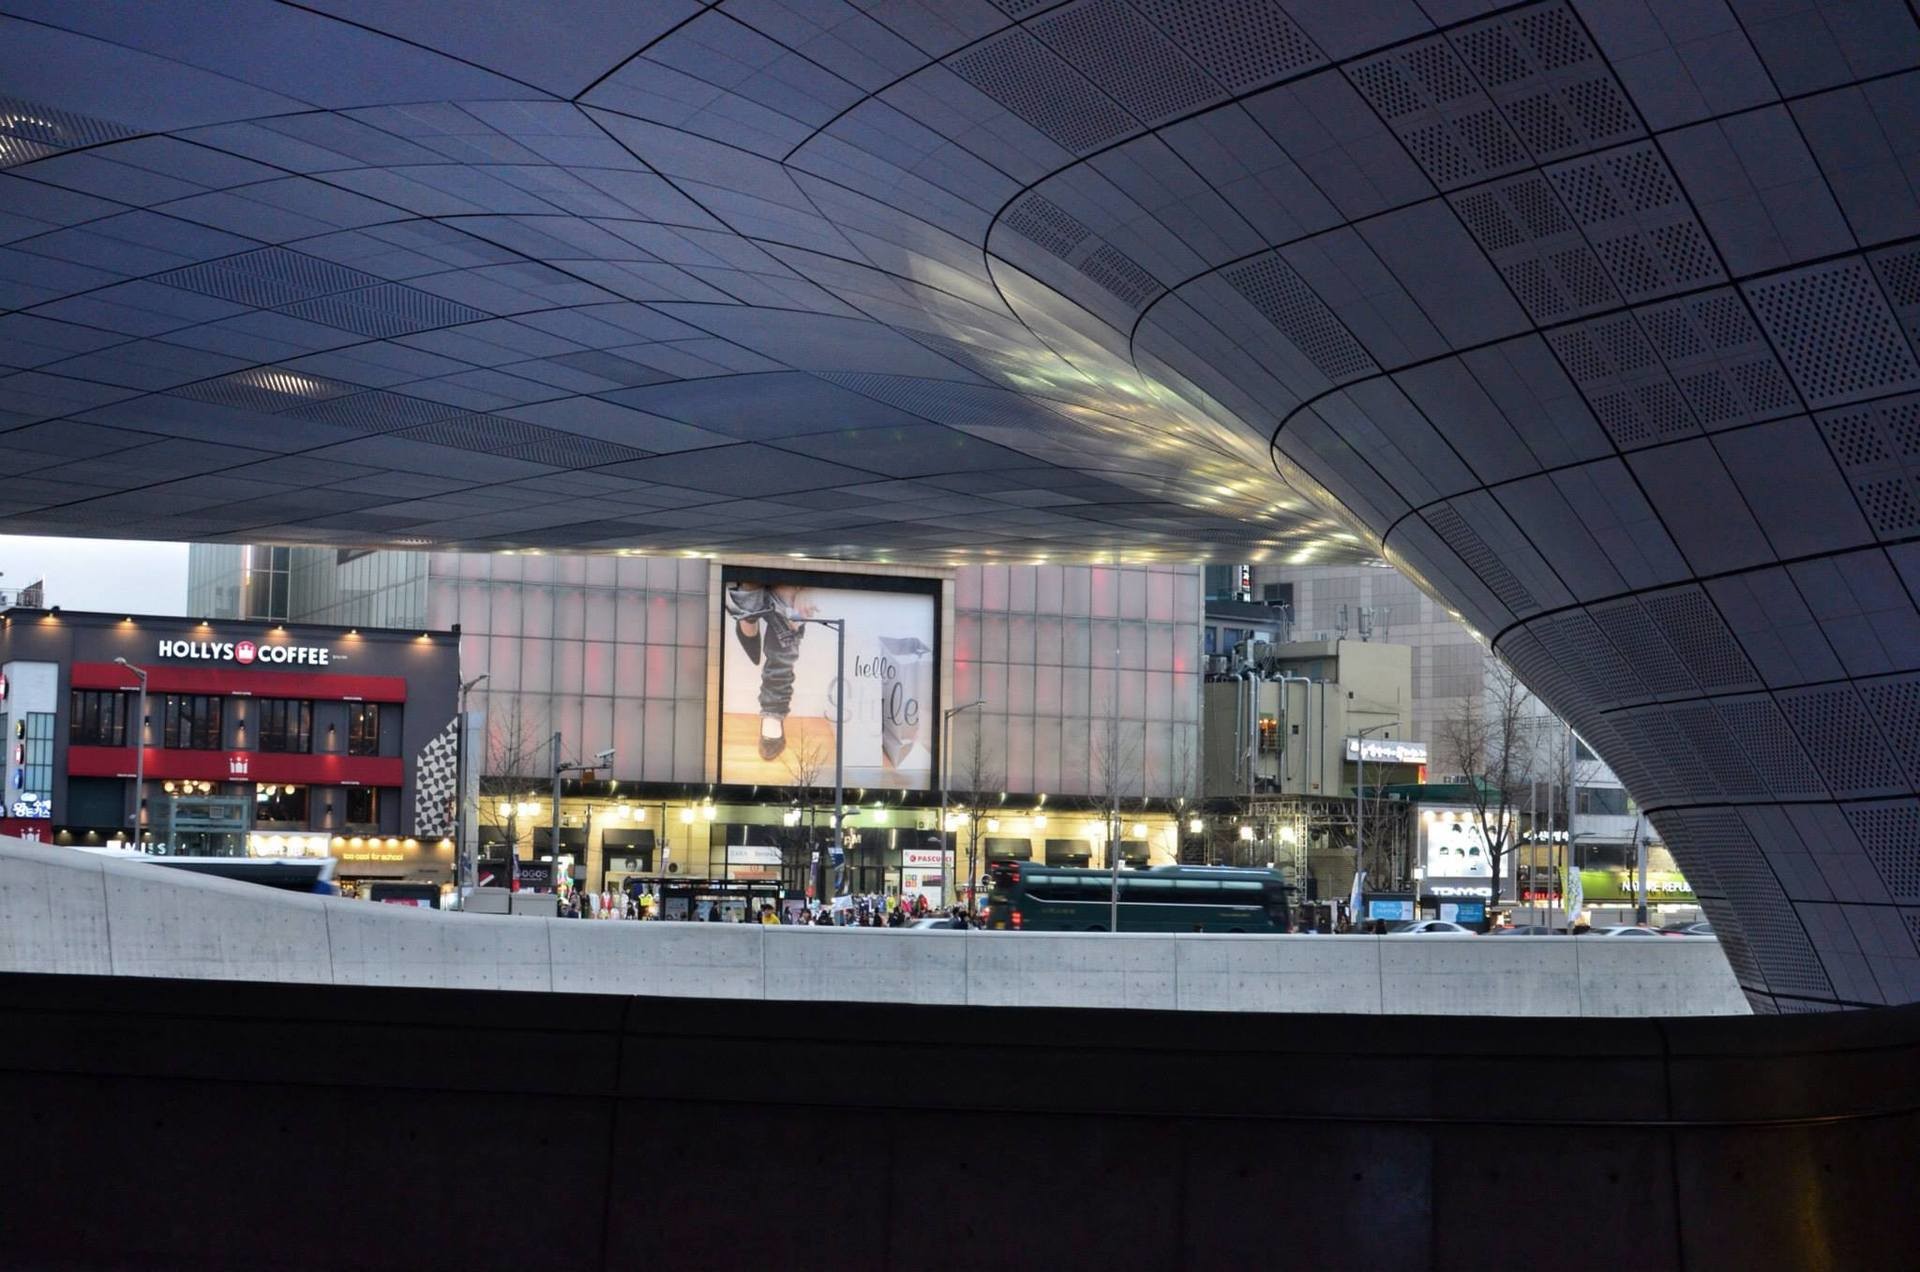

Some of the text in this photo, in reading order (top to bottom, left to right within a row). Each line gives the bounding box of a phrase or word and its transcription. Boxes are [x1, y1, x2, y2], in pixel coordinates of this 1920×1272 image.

[159, 640, 328, 665] HOLLYS COFFEE
[855, 655, 896, 680] hello
[1431, 886, 1506, 896] TONYMO
